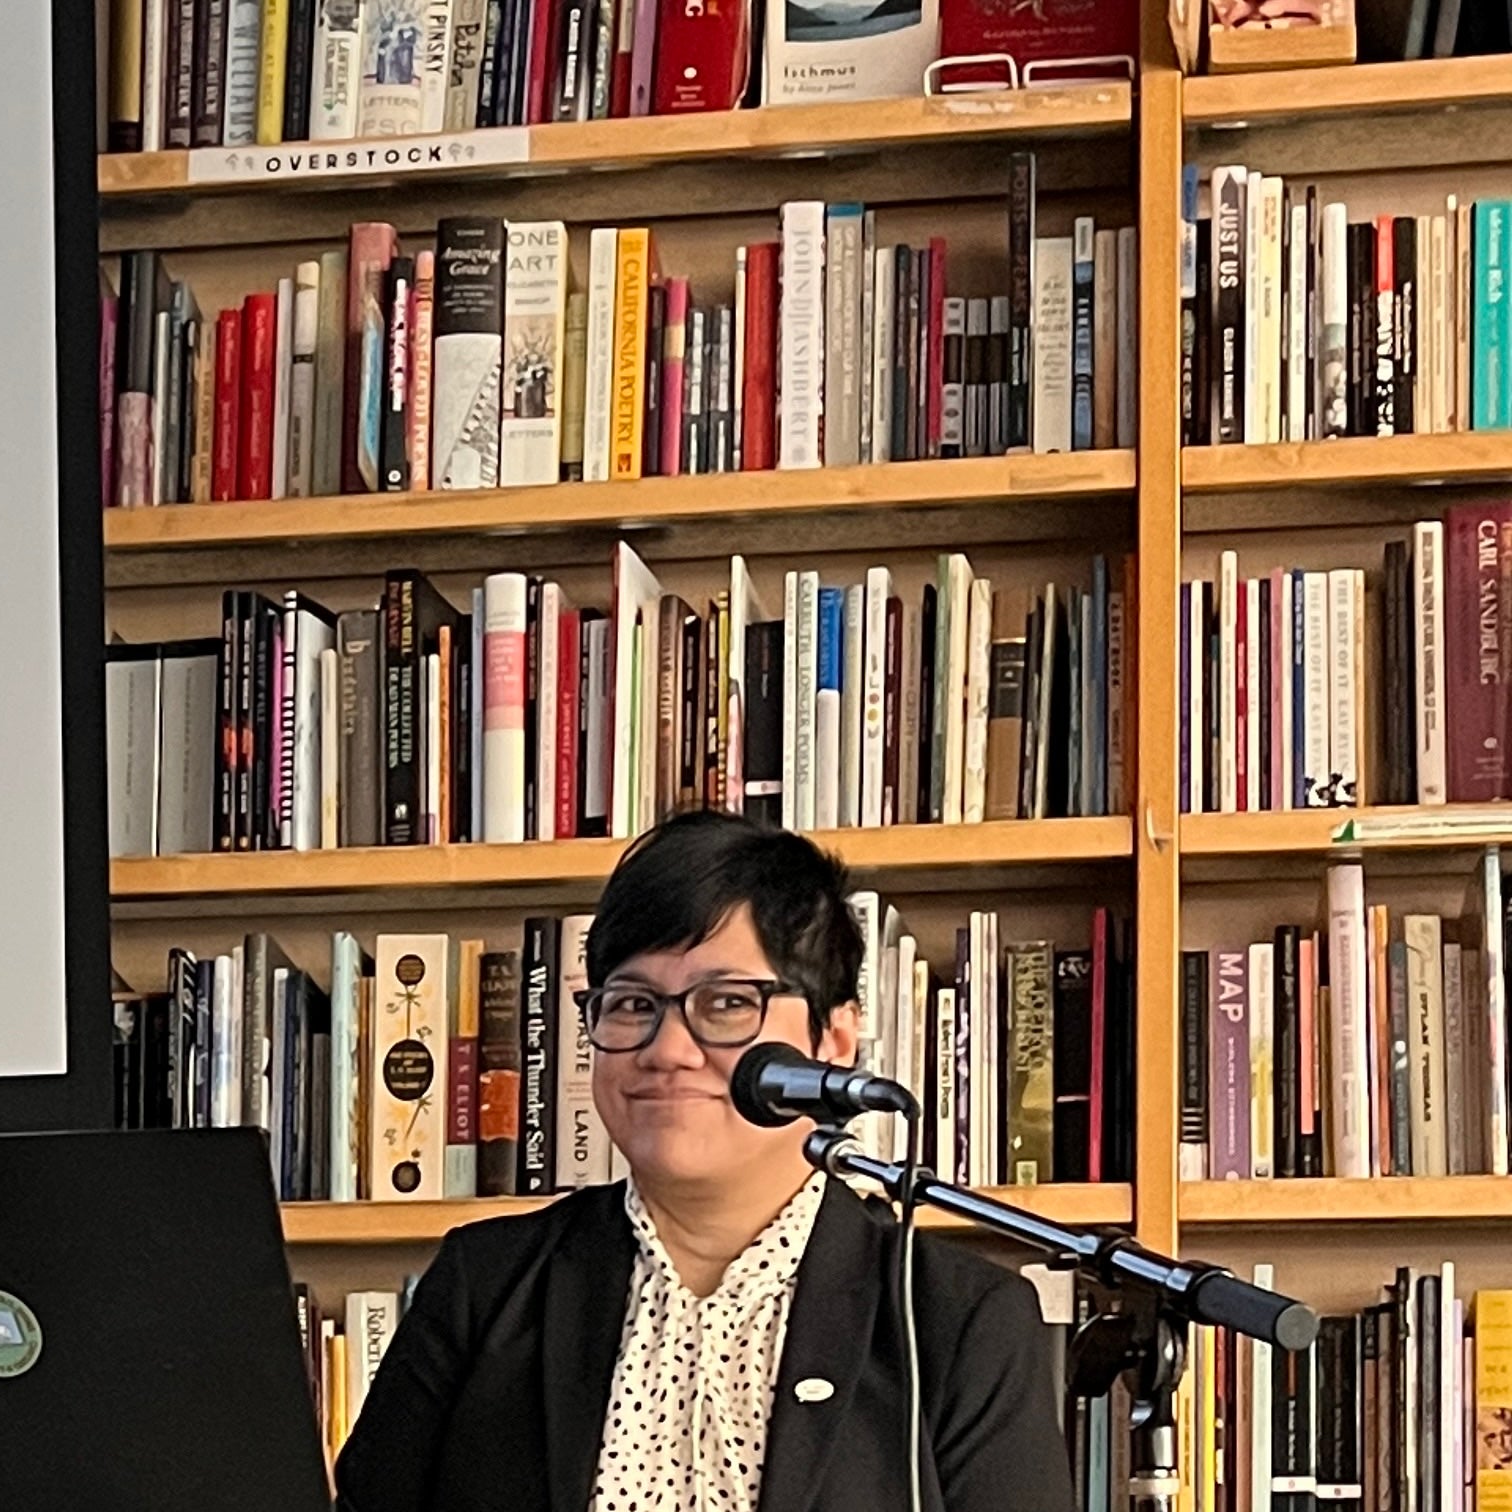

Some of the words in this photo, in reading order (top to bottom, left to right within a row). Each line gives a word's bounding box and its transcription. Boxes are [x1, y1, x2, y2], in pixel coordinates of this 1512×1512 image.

[426, 15, 446, 75] PINSKY
[227, 23, 259, 141] WILLIAMS
[265, 145, 443, 173] OVERSTOCK
[508, 229, 559, 247] ONE
[1219, 202, 1239, 254] JUST
[509, 255, 559, 272] ART
[791, 229, 813, 294] JOHN
[1219, 260, 1239, 289] US
[619, 259, 640, 369] CALIFORNIA
[789, 322, 810, 441] ASHBERY
[616, 376, 636, 444] POETRY
[1478, 519, 1498, 571] CARL
[1310, 583, 1322, 609] THE
[1337, 579, 1349, 606] THE
[799, 578, 814, 654] CARRUTH
[1310, 615, 1322, 650] BEST
[1337, 611, 1349, 646] BEST
[1478, 578, 1501, 685] SANDBURG
[401, 626, 413, 654] BELL
[1337, 650, 1350, 670] OF
[401, 665, 413, 687] THE
[1310, 654, 1322, 676] OF
[1338, 673, 1350, 688] IT
[798, 666, 812, 727] LONGER
[1311, 678, 1323, 694] IT
[400, 690, 413, 763] COLLECTED
[1311, 702, 1323, 732] KAY
[1338, 699, 1350, 730] KAY
[388, 729, 400, 768] POEMS
[797, 733, 811, 787] POEMS
[1311, 735, 1324, 775] RYAN
[1338, 732, 1351, 772] RYAN
[528, 965, 547, 1015] What
[1219, 952, 1244, 1022] MAP
[527, 1018, 547, 1048] the
[1420, 992, 1431, 1046] DYLAN
[459, 1044, 471, 1055] T
[525, 1049, 546, 1129] Thunder
[1423, 1052, 1432, 1122] THOMAS
[457, 1083, 470, 1141] ELIOT
[524, 1131, 545, 1170] Said
[574, 1109, 588, 1162] LAND
[367, 1306, 388, 1369] Robert
